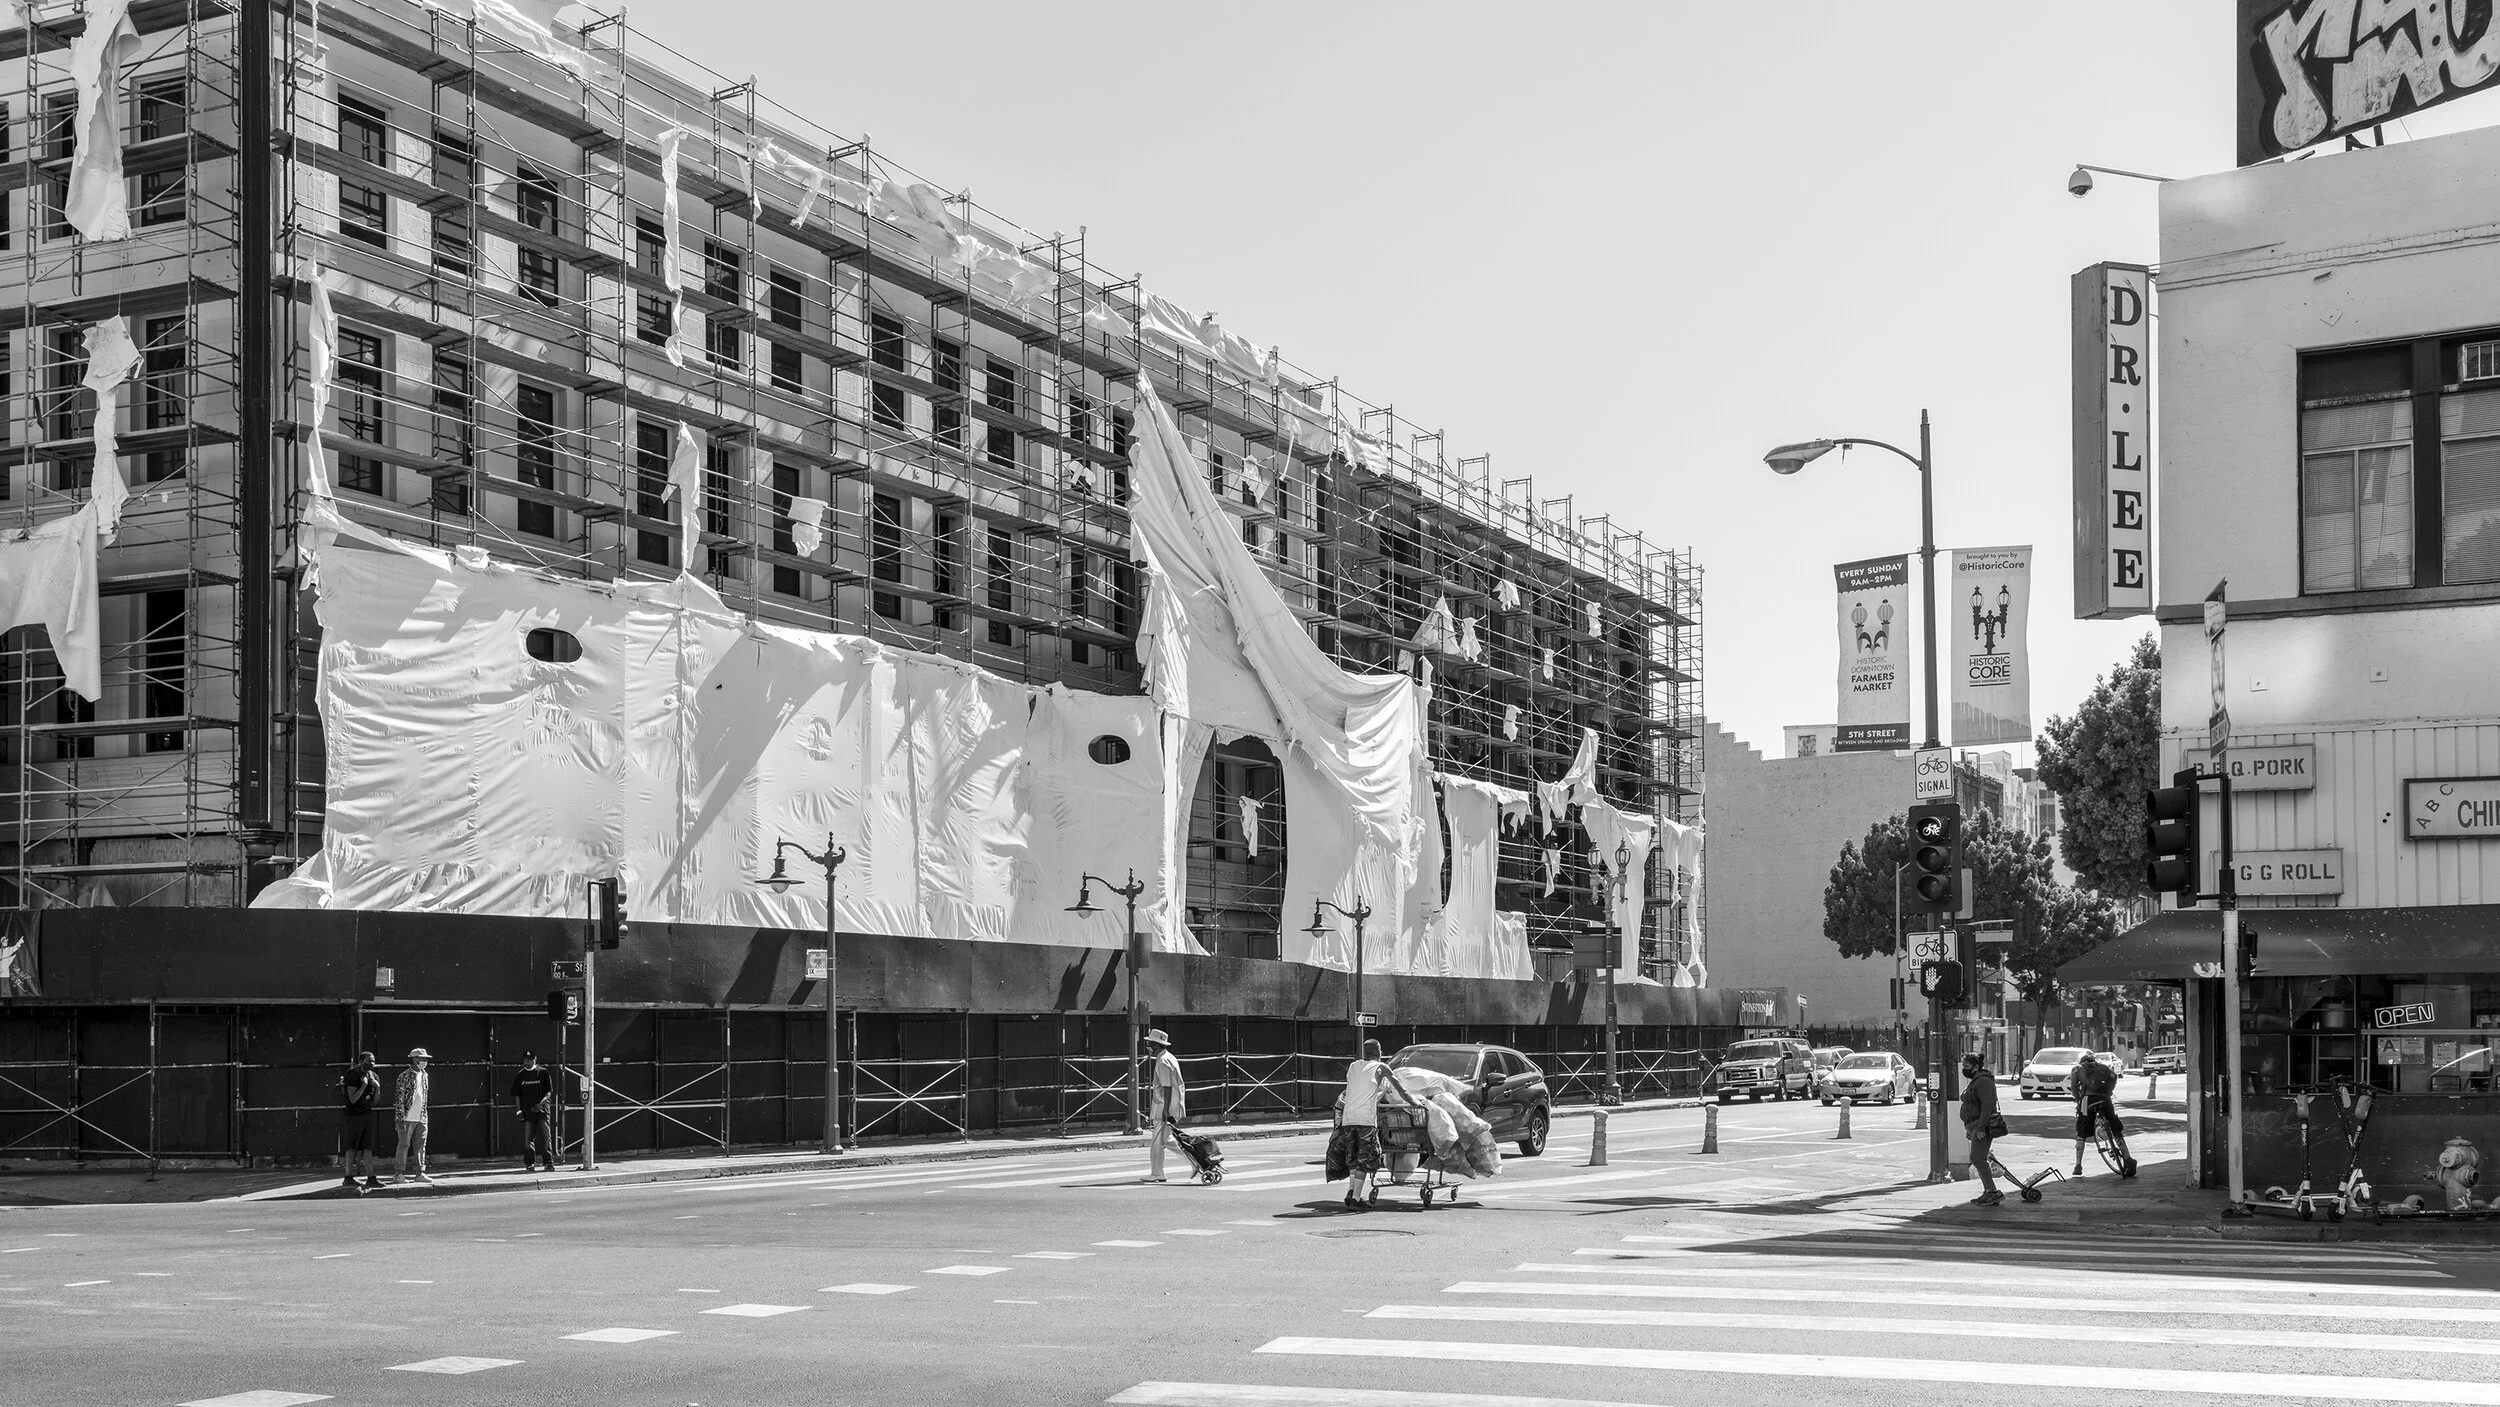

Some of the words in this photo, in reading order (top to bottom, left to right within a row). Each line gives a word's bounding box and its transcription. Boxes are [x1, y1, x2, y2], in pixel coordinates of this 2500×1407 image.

[1839, 568, 1865, 579] EVERY
[1867, 562, 1903, 575] SUNDAY
[1959, 560, 2025, 571] @HistoricCore
[1856, 656, 1887, 664] HISTORIC
[1969, 656, 2010, 666] HISTORIC
[1851, 664, 1895, 673] DOWNTOWN
[1969, 665, 2011, 679] CORE
[1851, 672, 1895, 683] FARMERS
[1853, 682, 1893, 692] MARKET
[1867, 729, 1896, 738] STREET
[2253, 758, 2305, 776] PORK
[1918, 779, 1950, 792] SIGNAL
[2281, 863, 2336, 880] ROLL
[575, 962, 583, 972] St
[2379, 1004, 2432, 1025] OPEN
[2383, 1040, 2396, 1052] A
